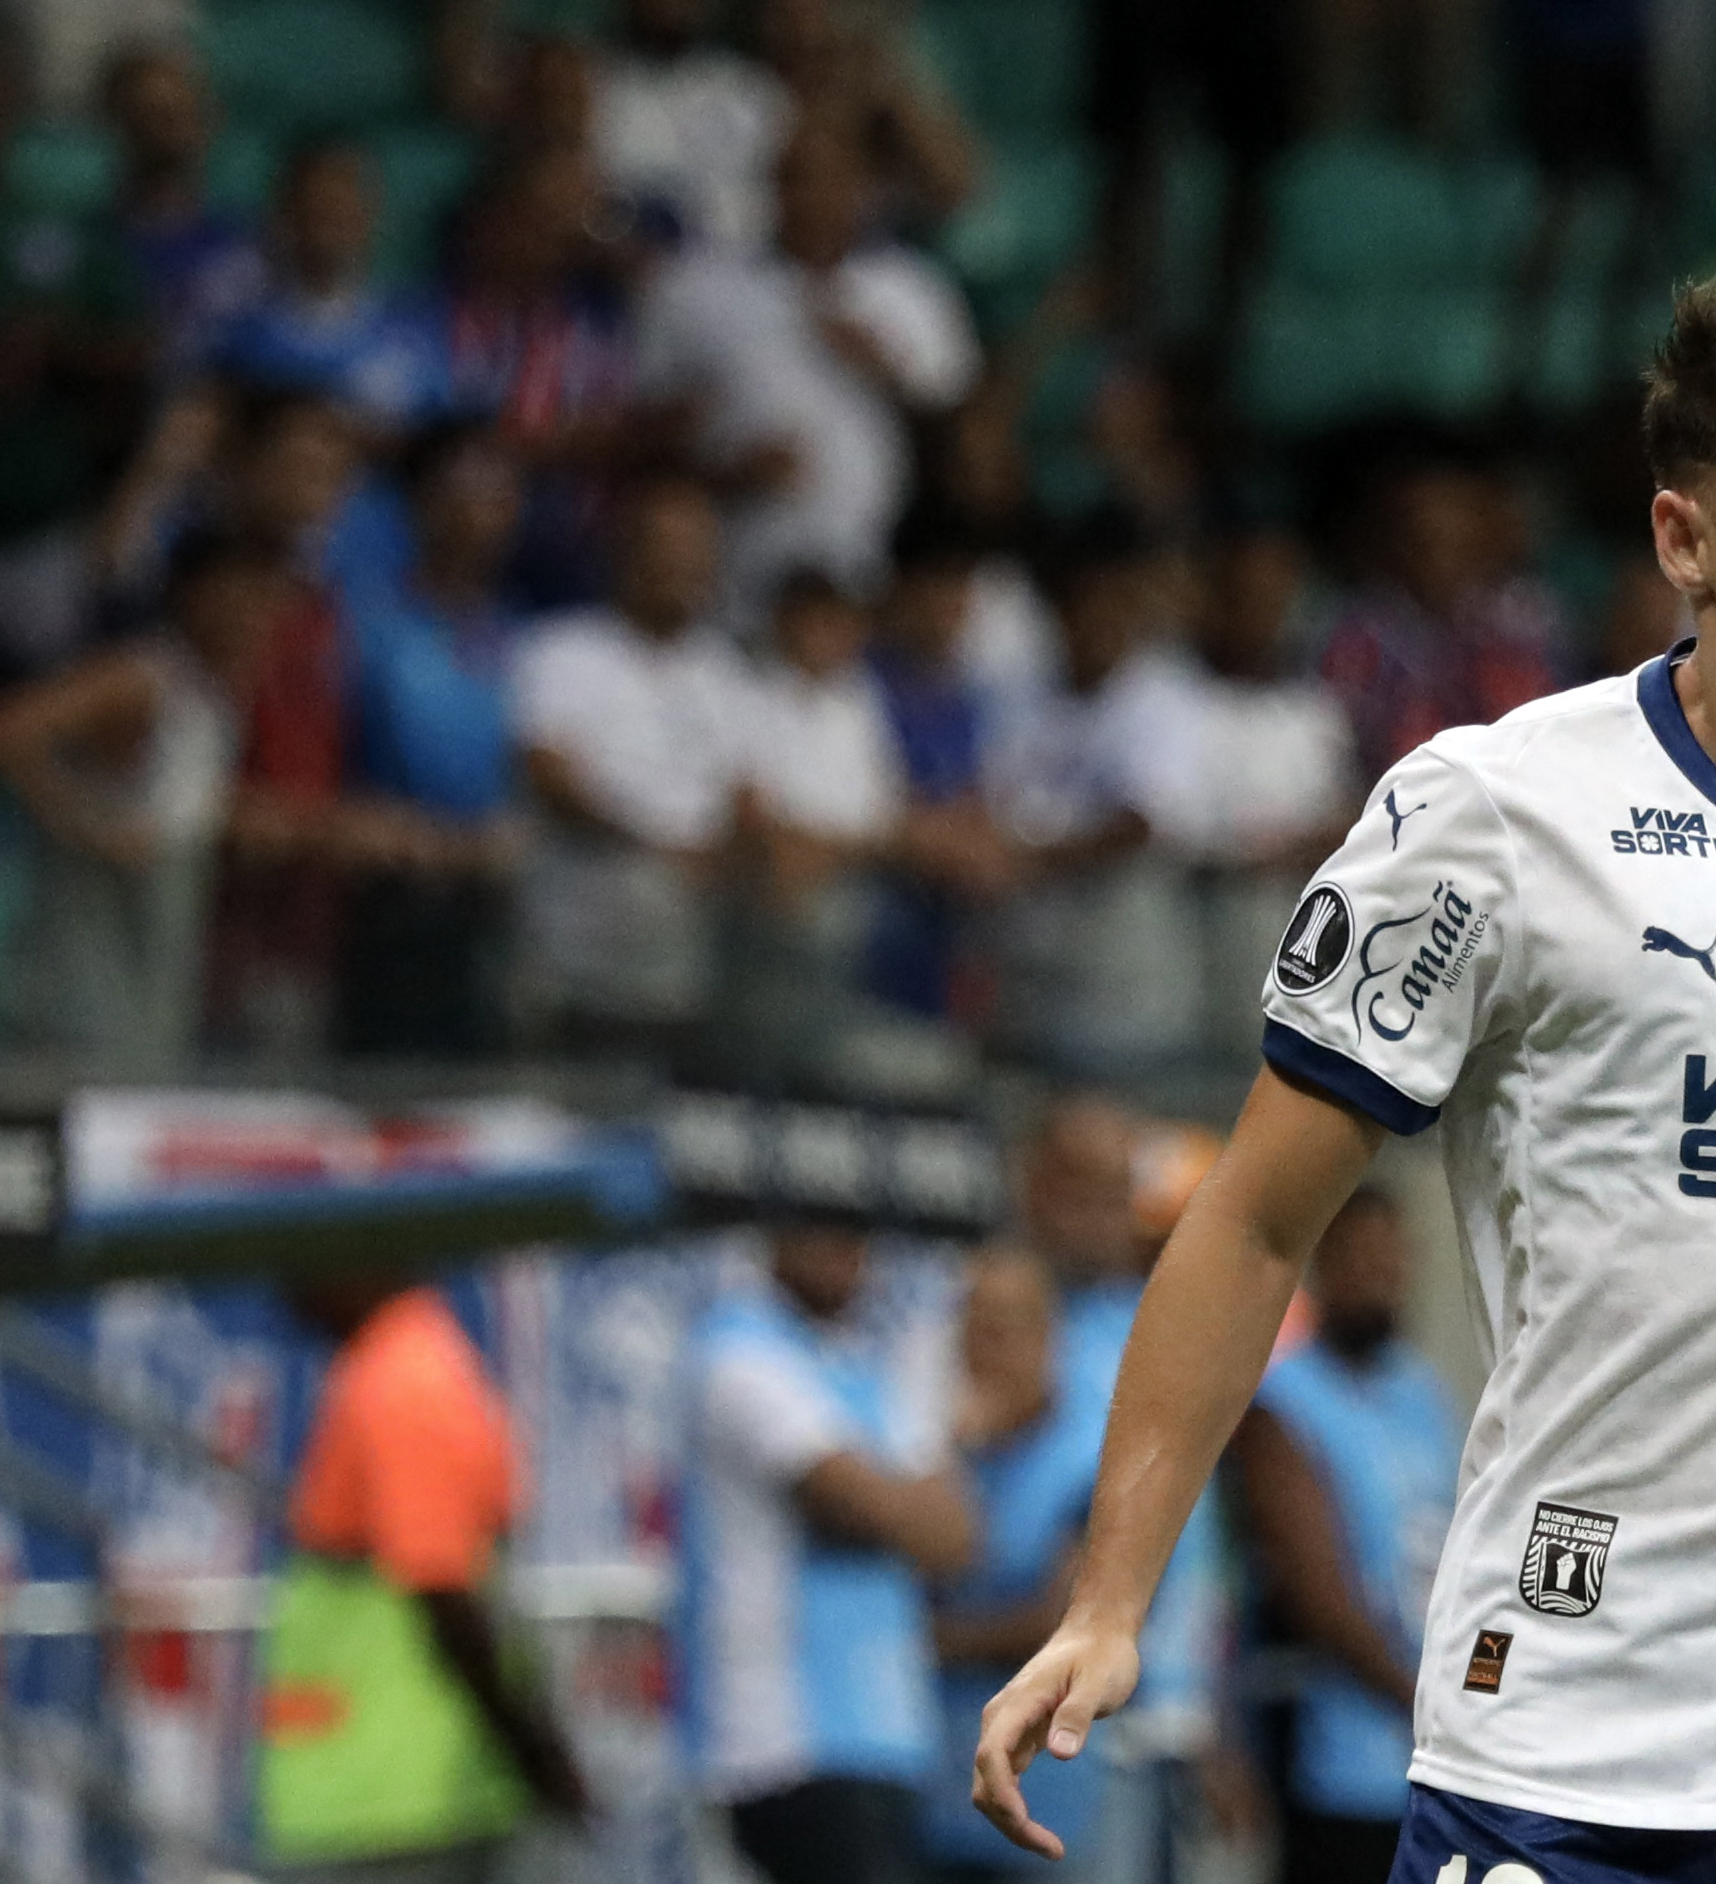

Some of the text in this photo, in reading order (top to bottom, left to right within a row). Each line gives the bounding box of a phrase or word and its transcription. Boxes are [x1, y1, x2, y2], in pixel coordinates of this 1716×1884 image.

[1629, 807, 1707, 834] VIVA
[1368, 880, 1472, 1041] Canaã
[1441, 911, 1488, 993] Alimentos
[1536, 1521, 1561, 1535] ANTE
[1560, 1525, 1571, 1537] EL
[1538, 1510, 1551, 1520] NO
[1578, 1516, 1593, 1528] LOS
